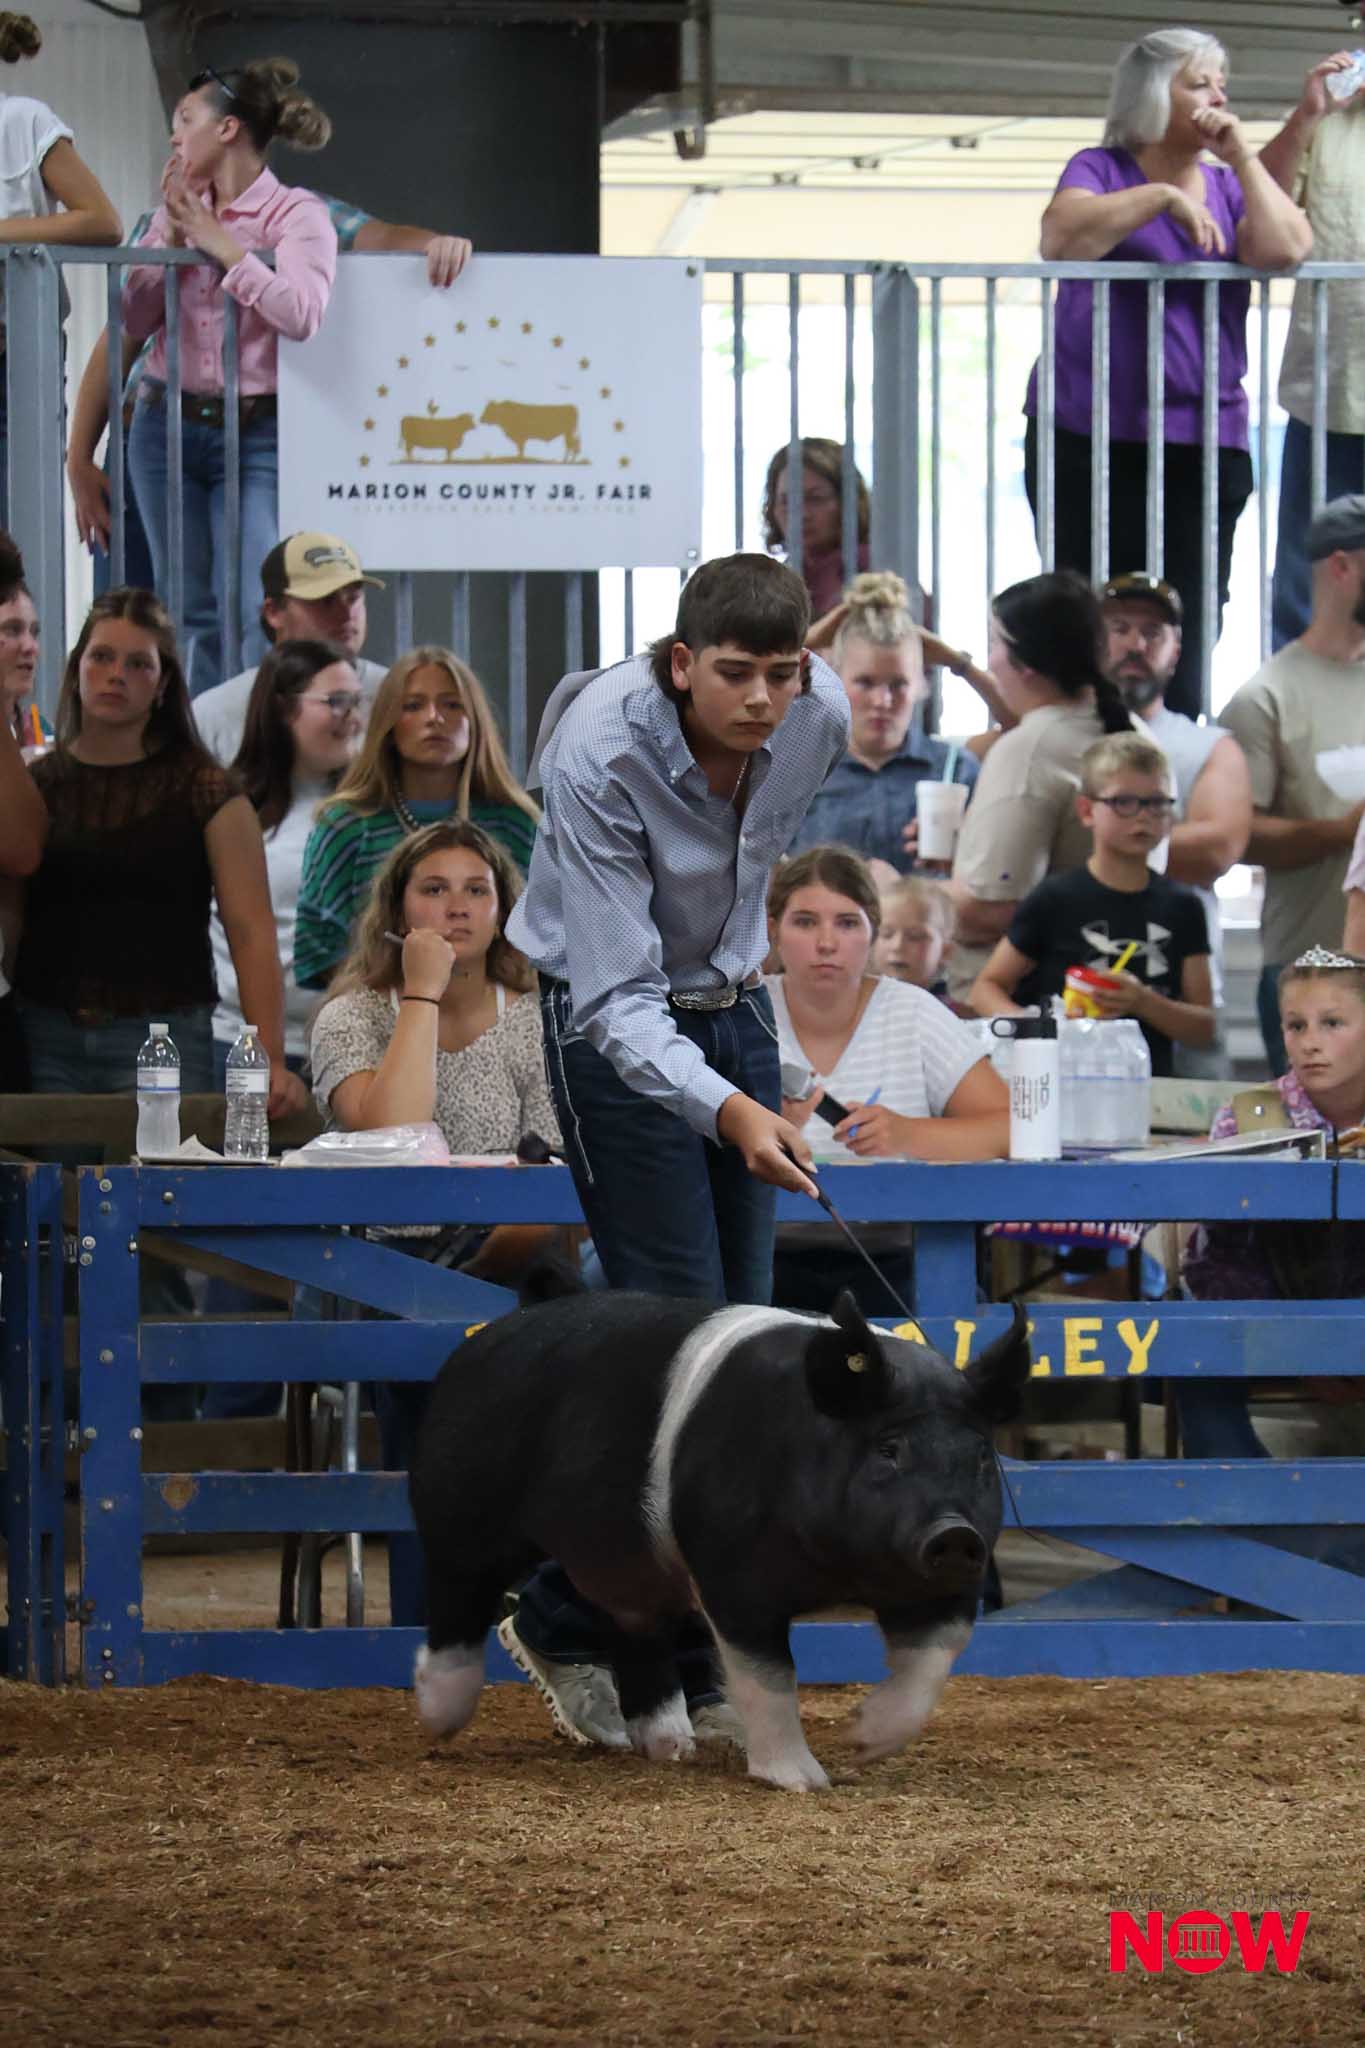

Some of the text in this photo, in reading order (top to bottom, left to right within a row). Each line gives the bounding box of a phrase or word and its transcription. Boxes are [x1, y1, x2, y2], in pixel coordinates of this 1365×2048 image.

[328, 483, 652, 500] MARION COUNTY JR. FAIR
